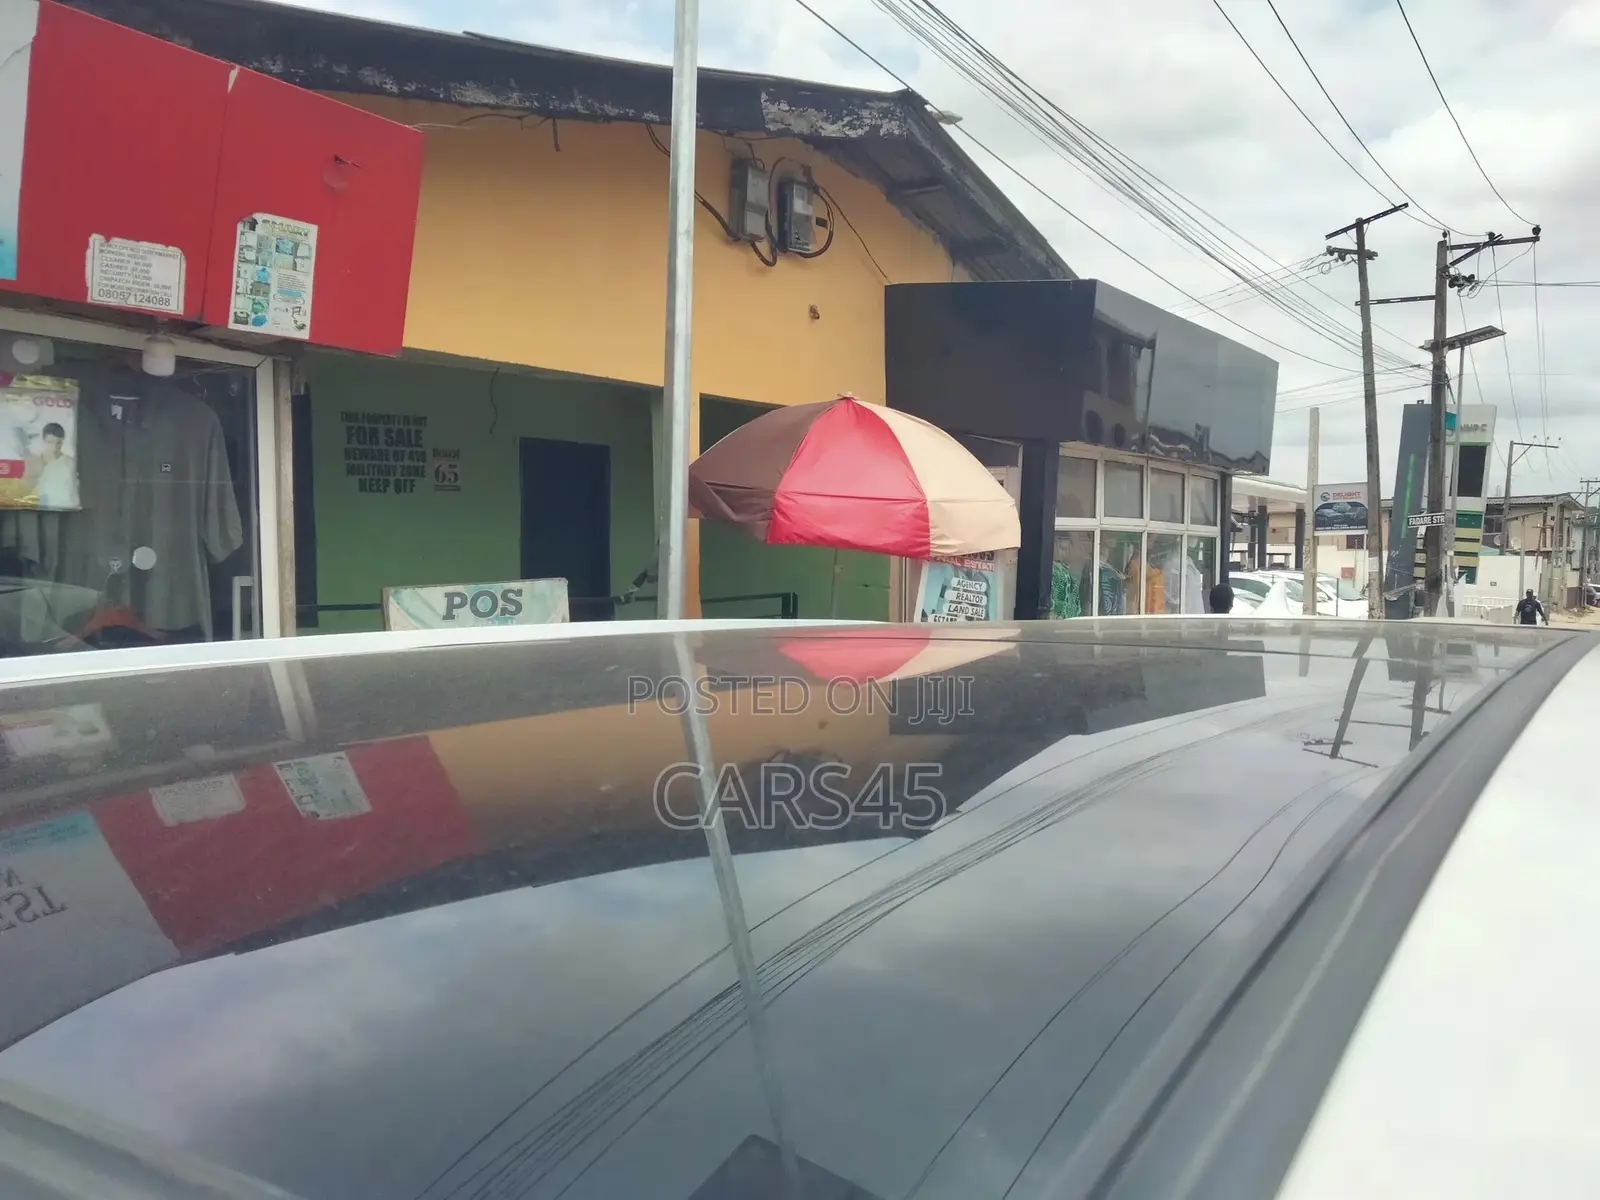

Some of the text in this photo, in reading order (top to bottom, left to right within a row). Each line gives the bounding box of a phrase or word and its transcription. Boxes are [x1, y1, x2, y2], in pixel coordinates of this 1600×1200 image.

[98, 288, 171, 307] 08057124088
[33, 396, 75, 408] GOLD
[346, 425, 424, 448] FOR SALE
[392, 449, 406, 462] OF
[400, 464, 427, 478] ZONE
[434, 464, 459, 484] 65
[358, 478, 416, 495] KEEP OFF
[956, 579, 983, 591] AGENCY
[442, 588, 523, 621] POS
[955, 592, 985, 604] REALTOR
[947, 604, 985, 618] LAND SALE
